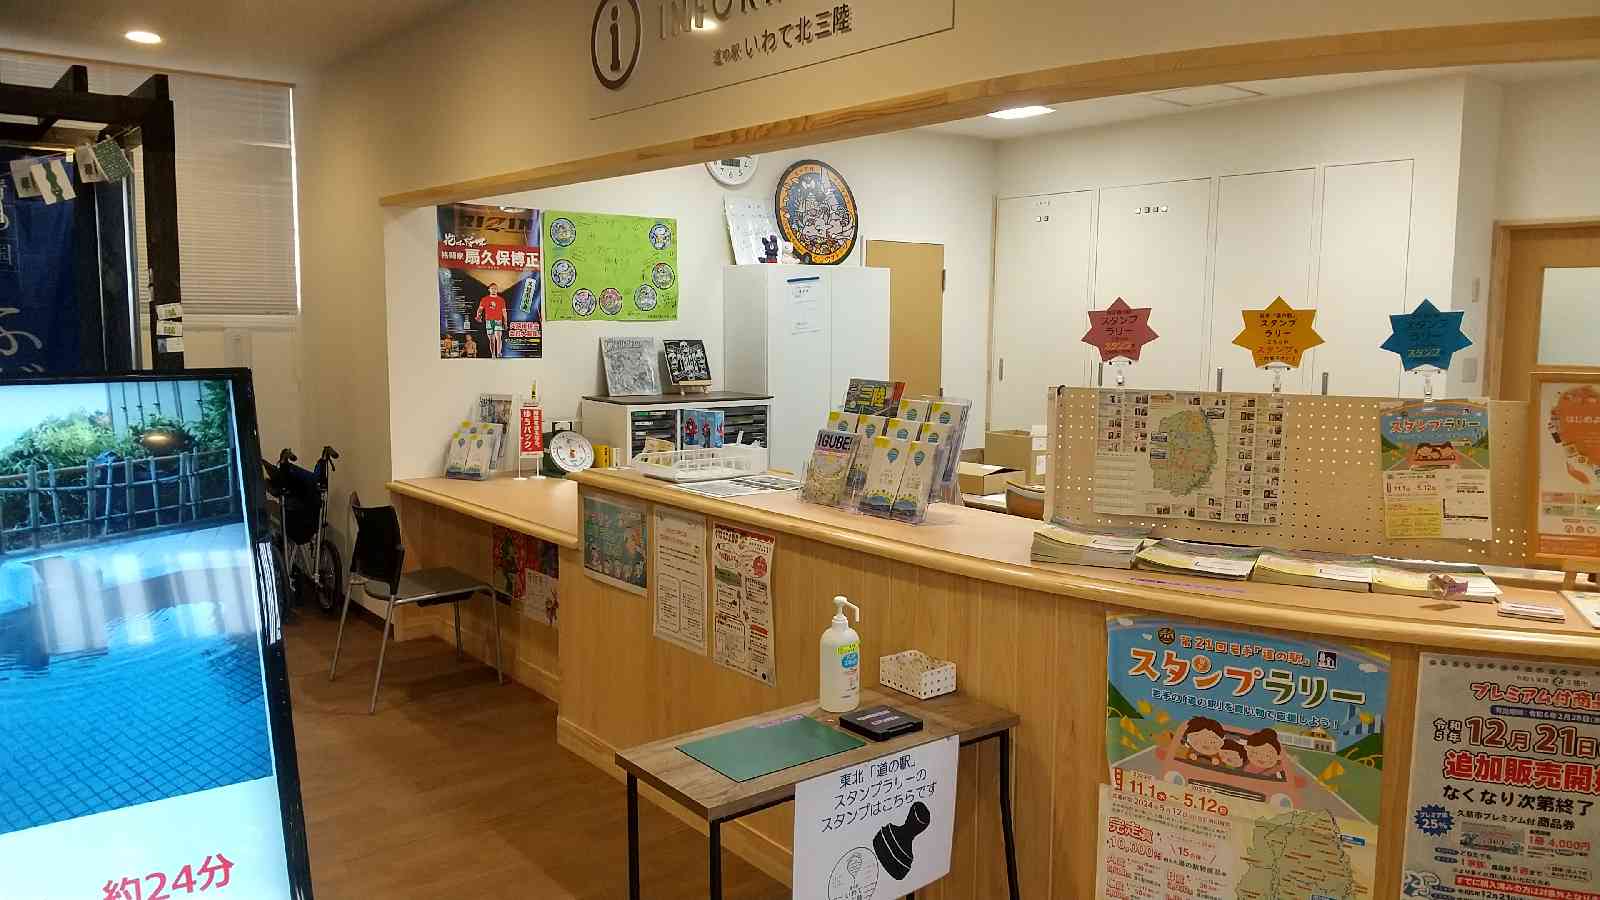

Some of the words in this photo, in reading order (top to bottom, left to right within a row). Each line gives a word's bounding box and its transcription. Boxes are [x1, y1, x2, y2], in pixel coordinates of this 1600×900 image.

[744, 4, 853, 59] いわて北三陸
[464, 248, 541, 268] 扇久保博正
[1104, 327, 1137, 336] ラリー
[1261, 319, 1297, 328] スタンプ
[1265, 329, 1292, 338] ラリー
[1391, 418, 1483, 434] スタンプラリー
[1127, 646, 1367, 710] スタンプラリー
[1465, 716, 1597, 759] 12月21日
[833, 768, 928, 810] スタンプラリーの
[1443, 750, 1600, 797] 追加販売開
[821, 782, 937, 833] スタンプはこちらです
[1443, 784, 1595, 816] なくなり次第終了
[103, 853, 235, 900] 約24分
